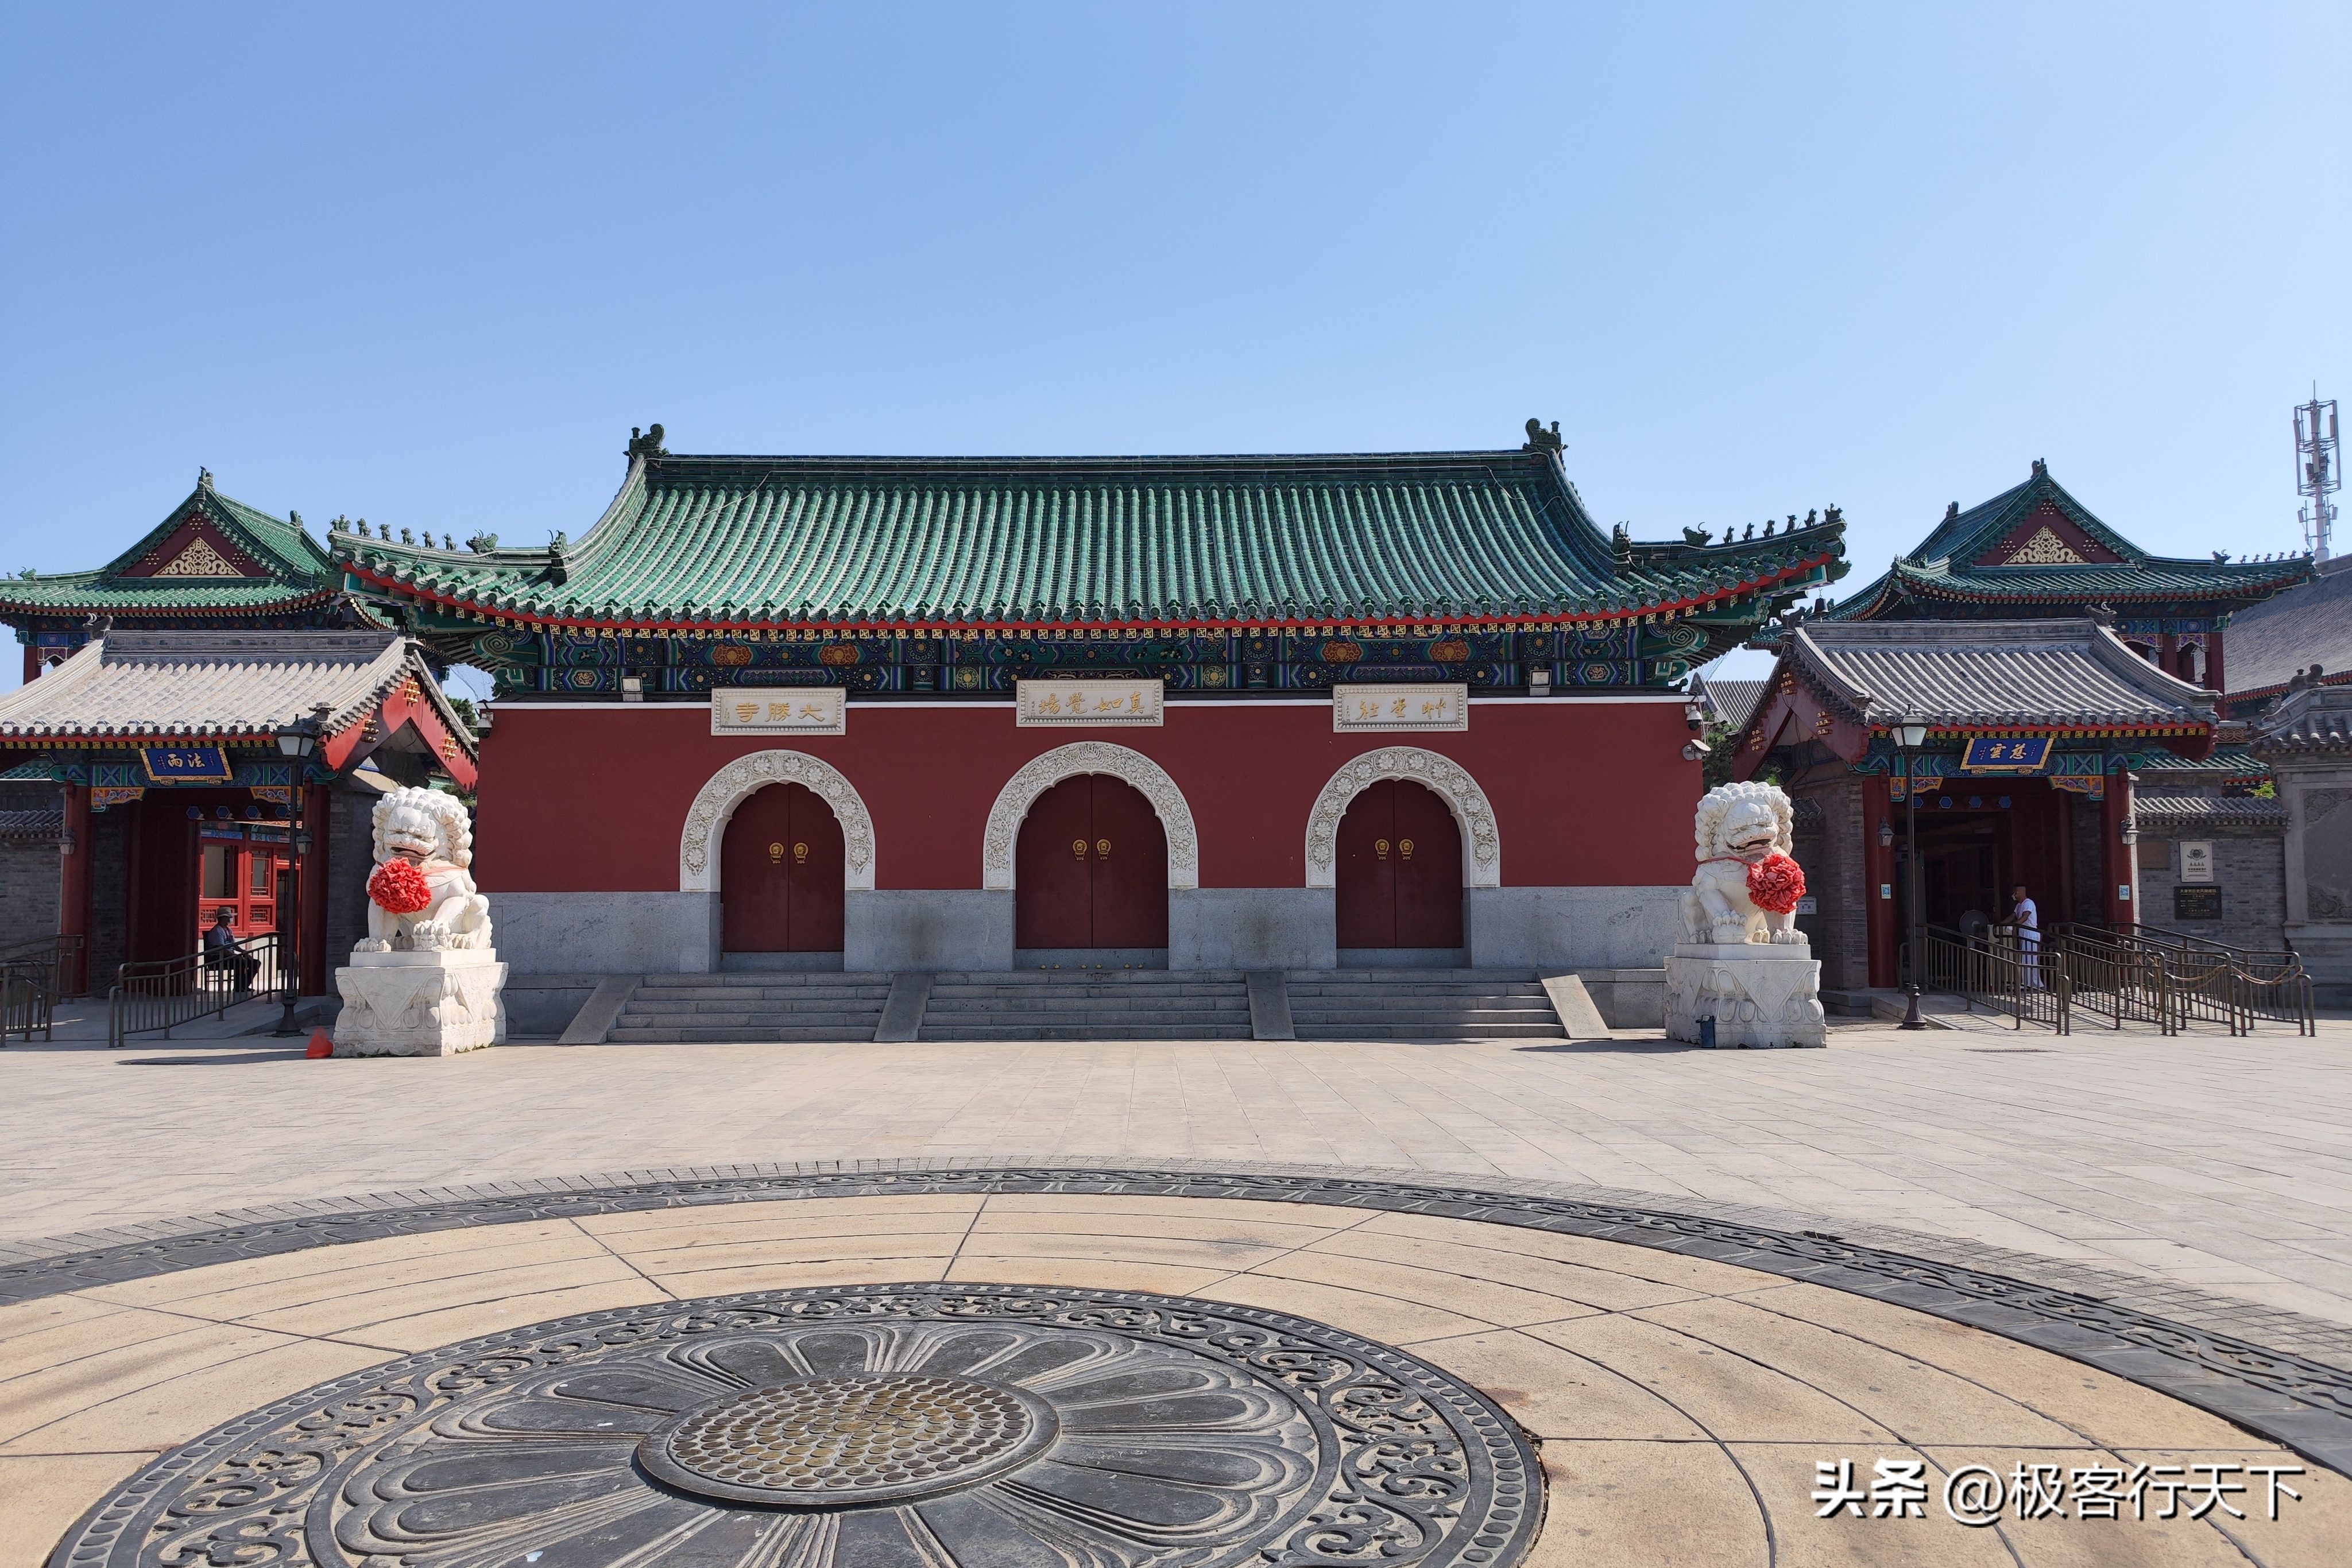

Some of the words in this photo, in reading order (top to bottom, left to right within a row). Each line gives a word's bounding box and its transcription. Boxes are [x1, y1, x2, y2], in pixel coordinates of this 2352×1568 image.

[735, 702, 826, 723] 大勝寺
[1038, 691, 1145, 715] 真如覺場
